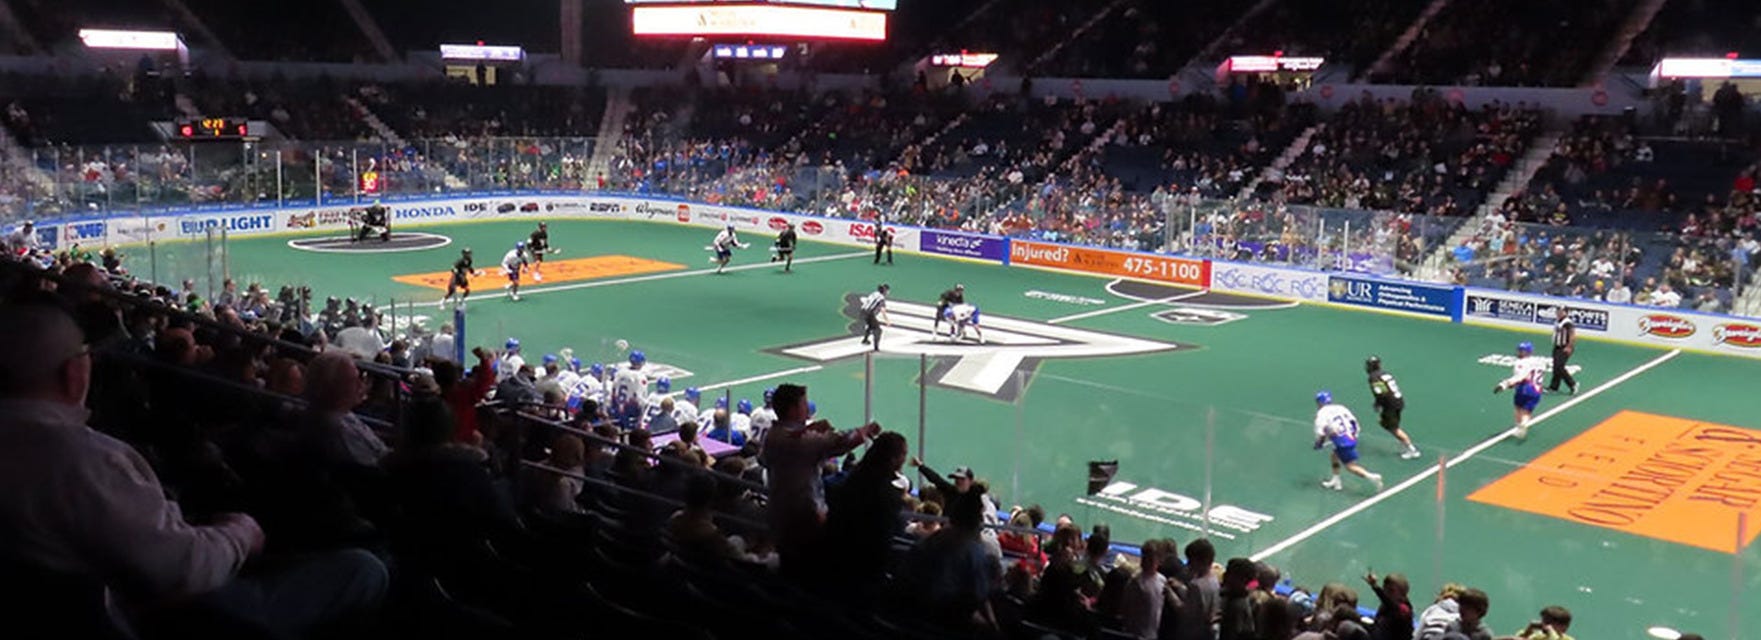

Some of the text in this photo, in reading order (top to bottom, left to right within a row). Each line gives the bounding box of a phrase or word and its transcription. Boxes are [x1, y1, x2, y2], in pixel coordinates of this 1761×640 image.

[395, 205, 456, 219] HONDA
[463, 203, 488, 212] IDE
[590, 202, 621, 213] ESPN
[181, 219, 219, 234] BUD
[222, 215, 272, 231] LIGHT
[1011, 243, 1069, 263] Injured?
[1123, 257, 1200, 280] 475-1100
[1347, 280, 1372, 298] UR
[1499, 300, 1532, 311] SENECA
[1100, 481, 1275, 530] IDE
